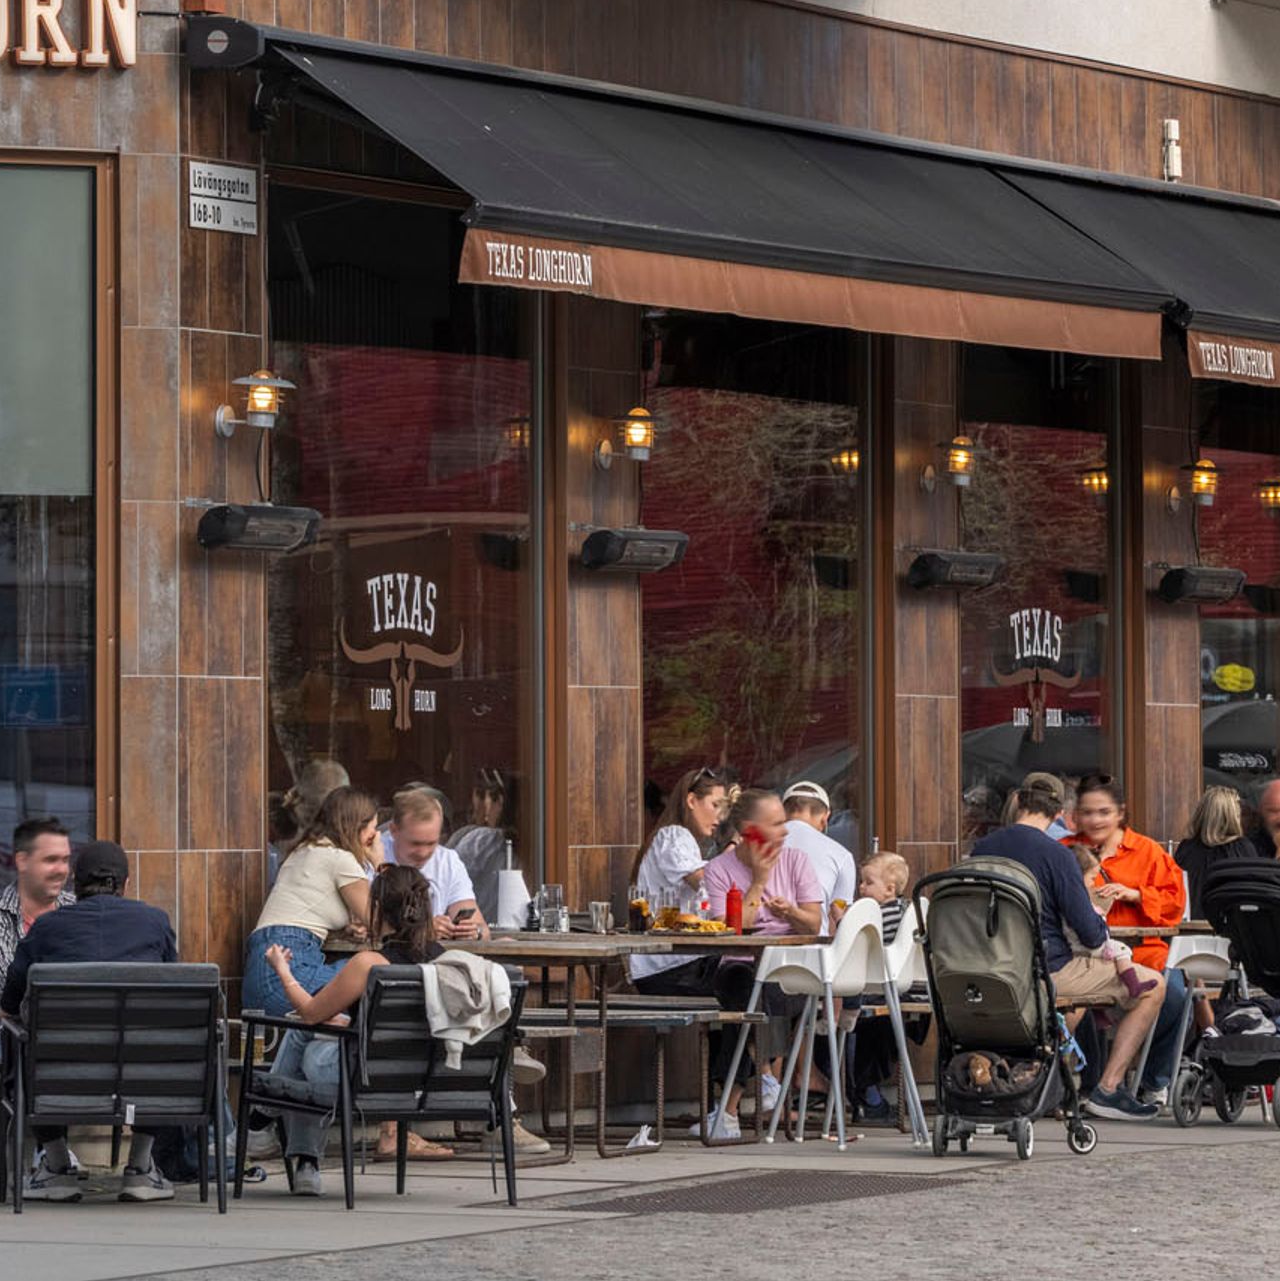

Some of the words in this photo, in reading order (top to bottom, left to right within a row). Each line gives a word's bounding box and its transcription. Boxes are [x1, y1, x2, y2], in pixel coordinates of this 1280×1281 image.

[192, 168, 250, 198] Lövängsgatan
[193, 202, 222, 225] 16B-10
[486, 242, 525, 279] TEXAS
[528, 247, 593, 286] LONGHORN
[1199, 341, 1228, 373] TEXAS
[1229, 344, 1275, 380] LONGHORN
[367, 572, 438, 637] TEXAS
[1009, 607, 1063, 664] TEXAS
[370, 688, 392, 711] LONG
[414, 689, 437, 712] HORN
